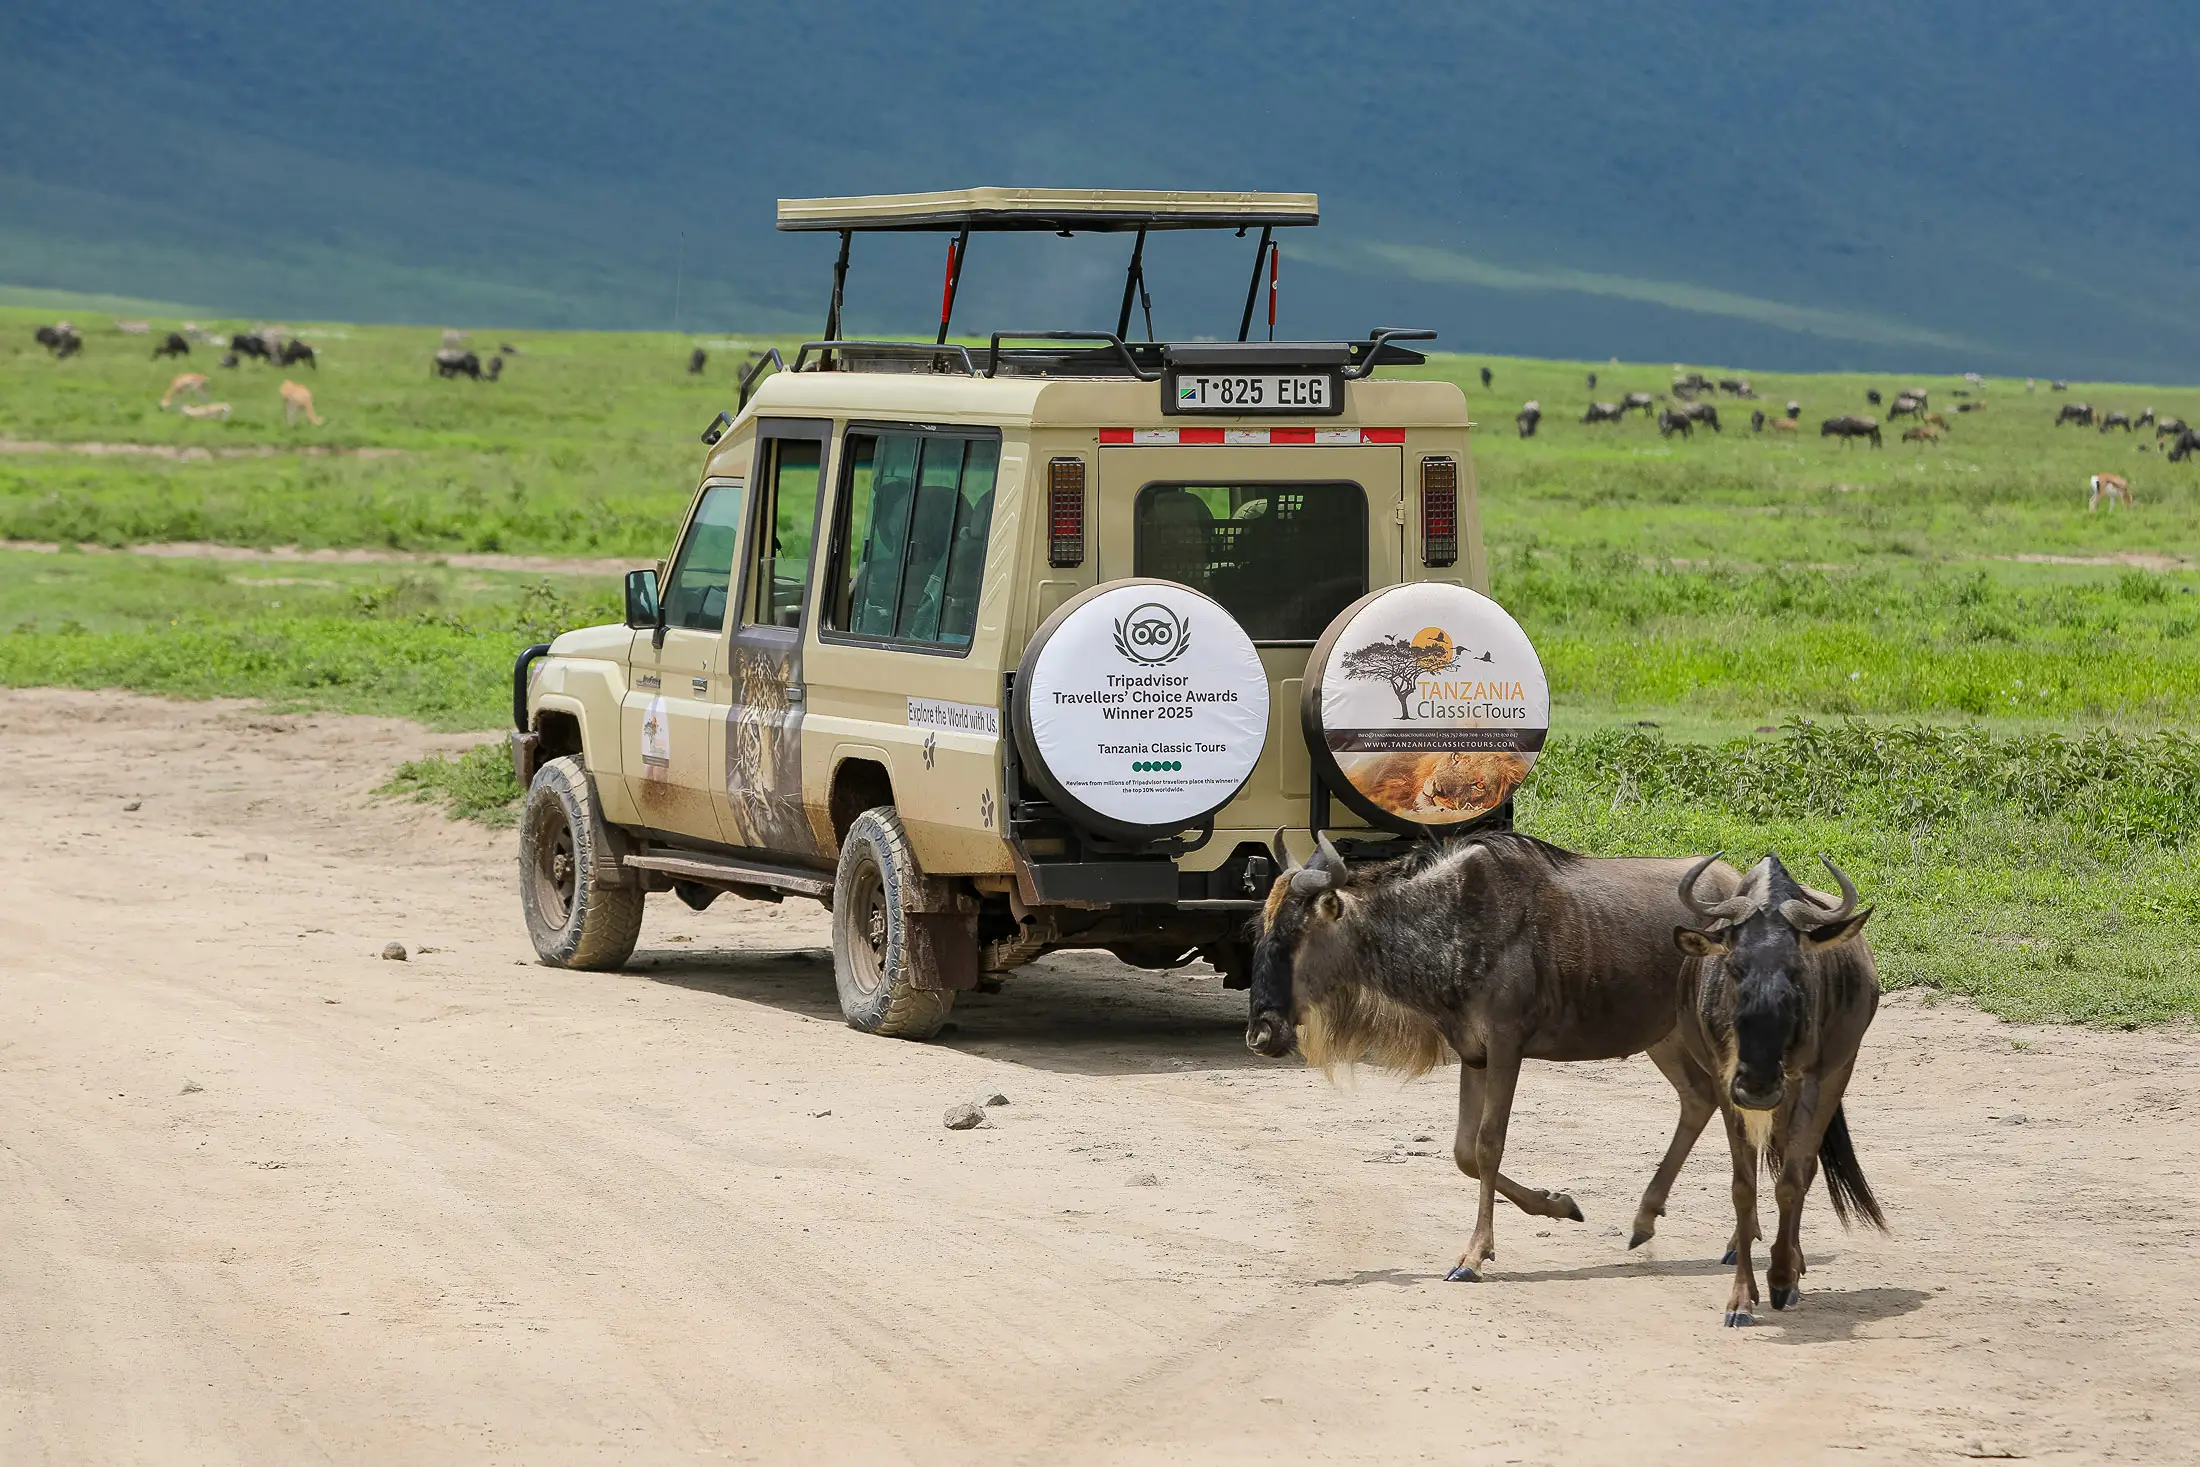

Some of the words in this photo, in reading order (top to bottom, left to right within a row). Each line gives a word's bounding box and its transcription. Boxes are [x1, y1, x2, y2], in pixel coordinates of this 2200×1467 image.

[1196, 378, 1210, 404] T
[1220, 378, 1263, 404] 825
[1278, 378, 1322, 404] ELG
[1107, 674, 1189, 690] Tripadvisor
[1053, 691, 1128, 704] Travellers’
[1132, 690, 1182, 703] Choice
[1186, 690, 1238, 703] Awards
[1417, 681, 1525, 700] TANZANIA
[908, 702, 934, 726] Explore
[935, 705, 947, 725] the
[947, 707, 969, 729] World
[969, 710, 985, 731] with
[986, 713, 998, 733] Us.
[1102, 707, 1155, 719] Winner
[1157, 706, 1194, 719] 2025
[1097, 743, 1149, 754] Tanzania
[1151, 742, 1192, 753] Classic
[1194, 742, 1226, 753] Tours
